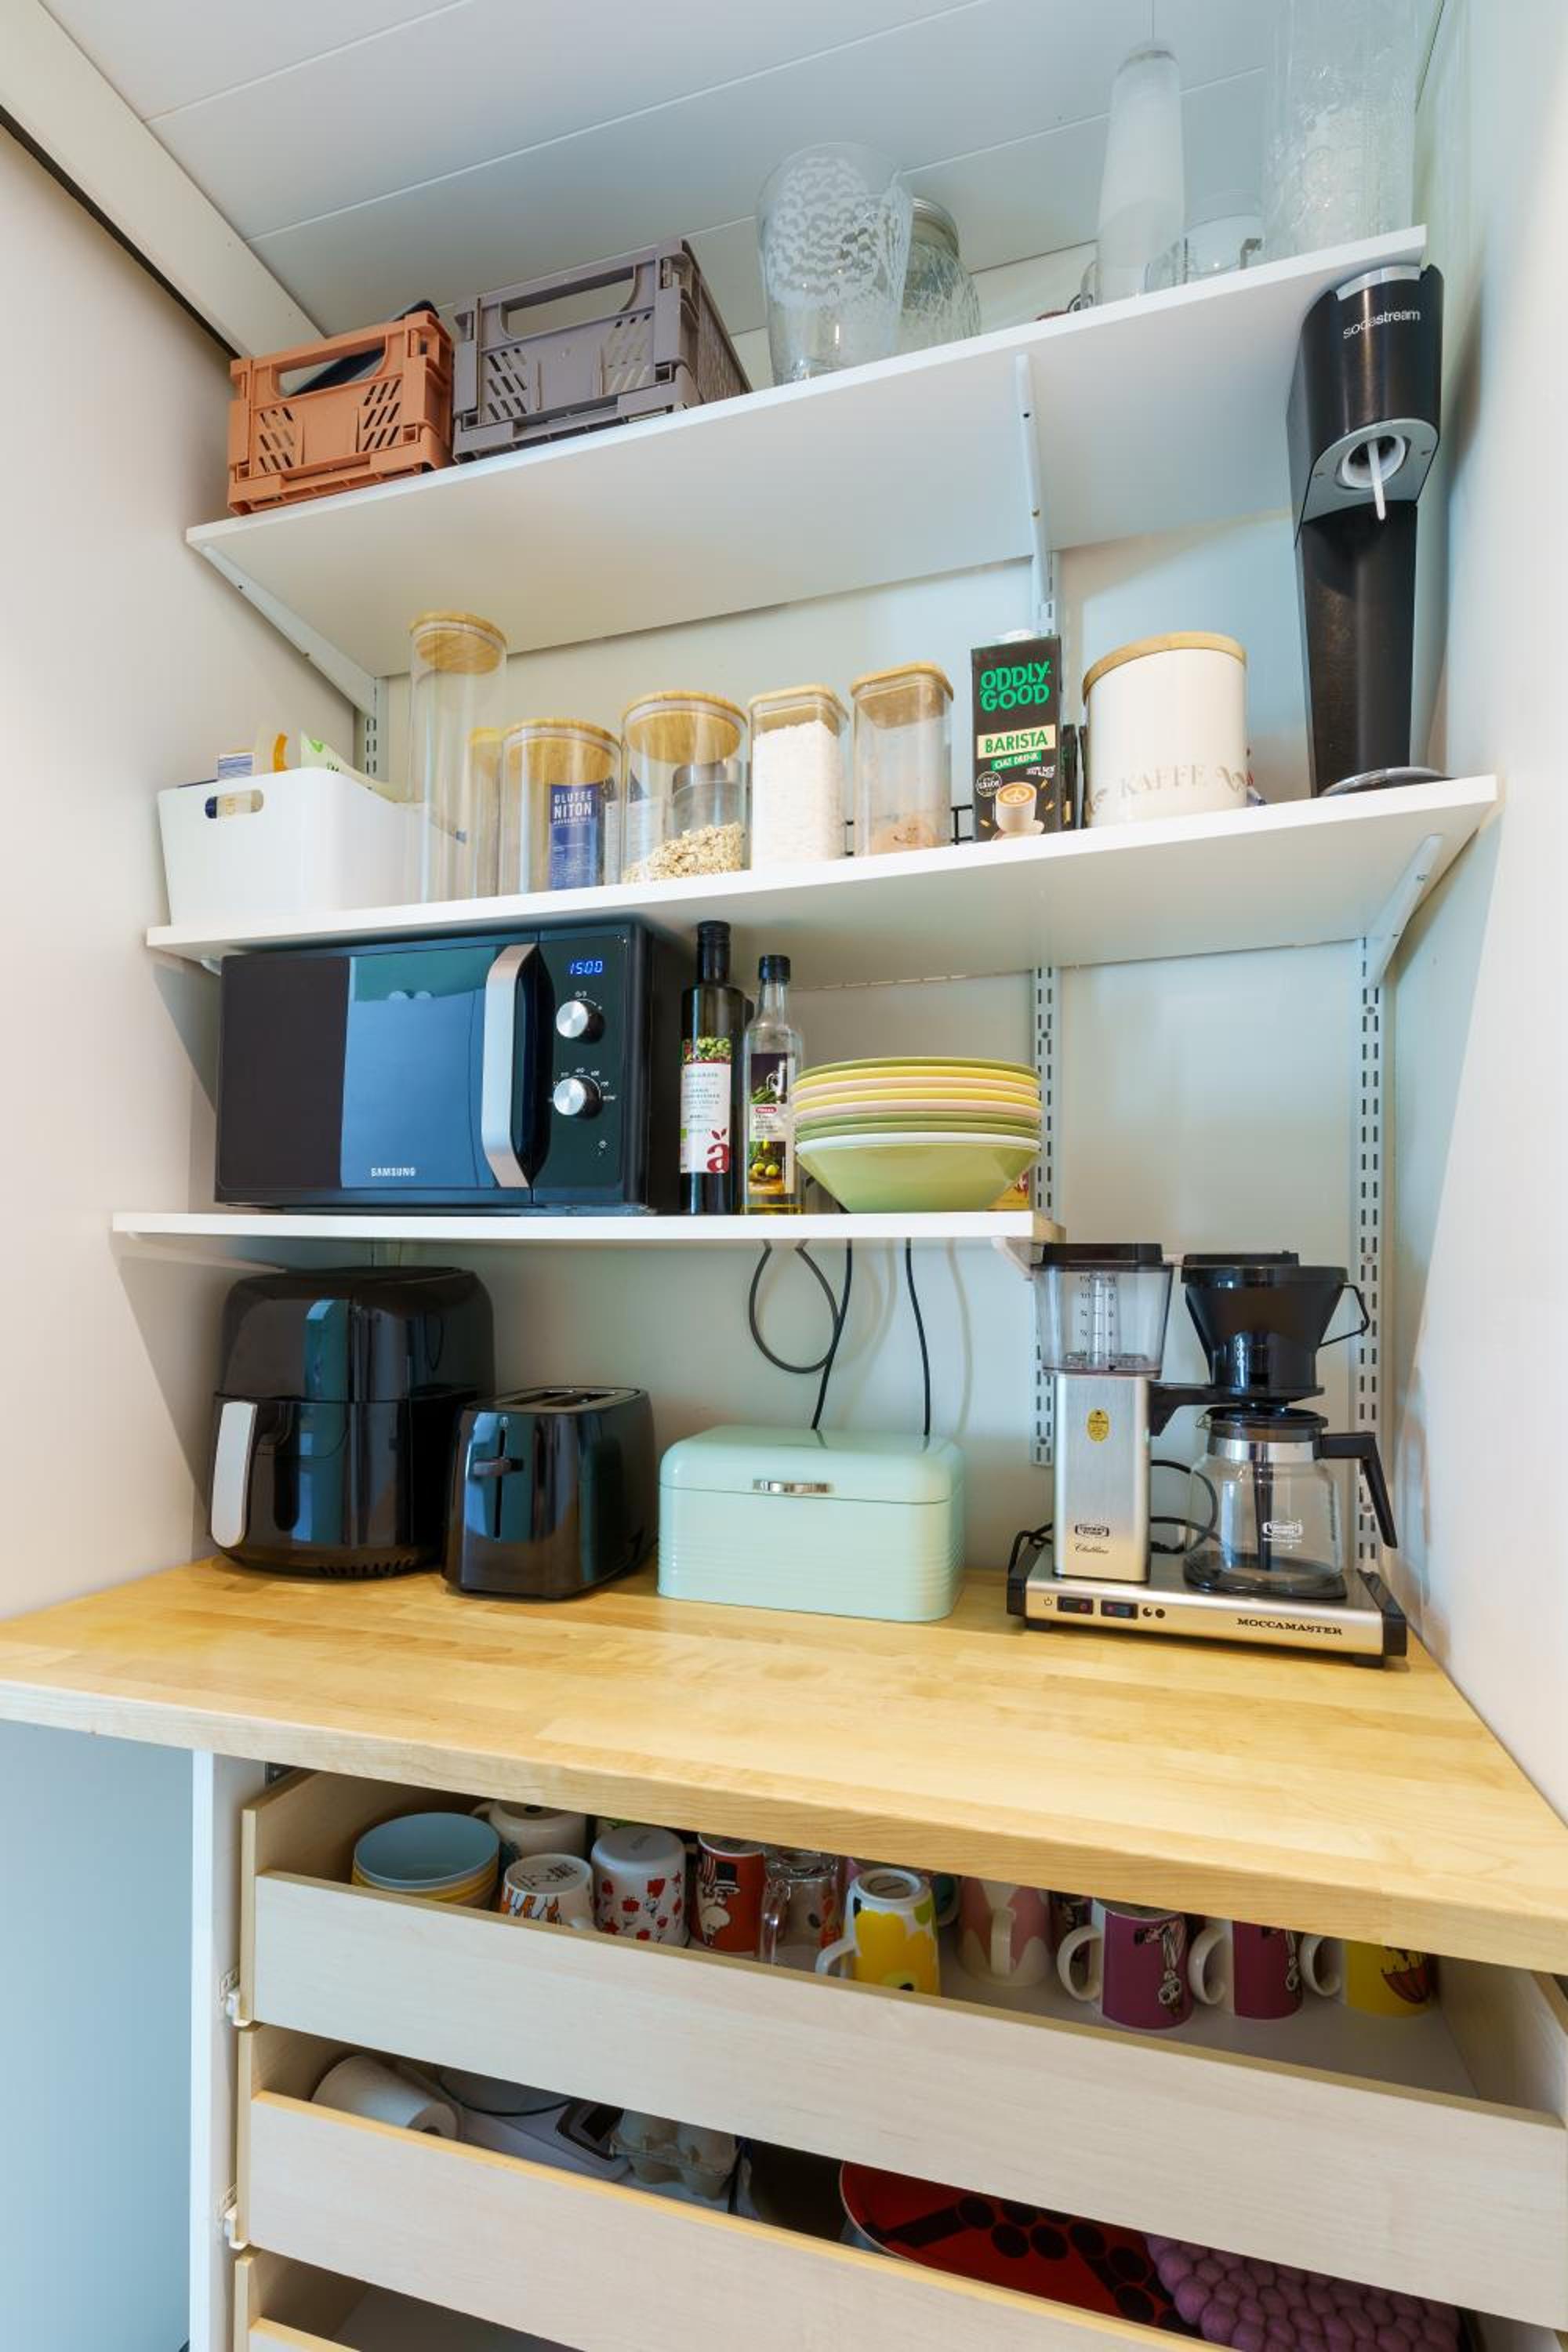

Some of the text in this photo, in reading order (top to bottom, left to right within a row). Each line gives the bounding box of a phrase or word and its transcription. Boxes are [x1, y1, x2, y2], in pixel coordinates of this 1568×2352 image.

[1343, 310, 1421, 339] sodastream
[981, 661, 1048, 691] ODDLY
[980, 684, 1051, 712] GOOD
[985, 730, 1048, 753] BARISTA
[1120, 765, 1205, 798] KAFFE
[554, 801, 593, 819] NITON
[371, 1167, 416, 1177] SAMSUNG
[1236, 1617, 1343, 1635] MOCCAMASTER
